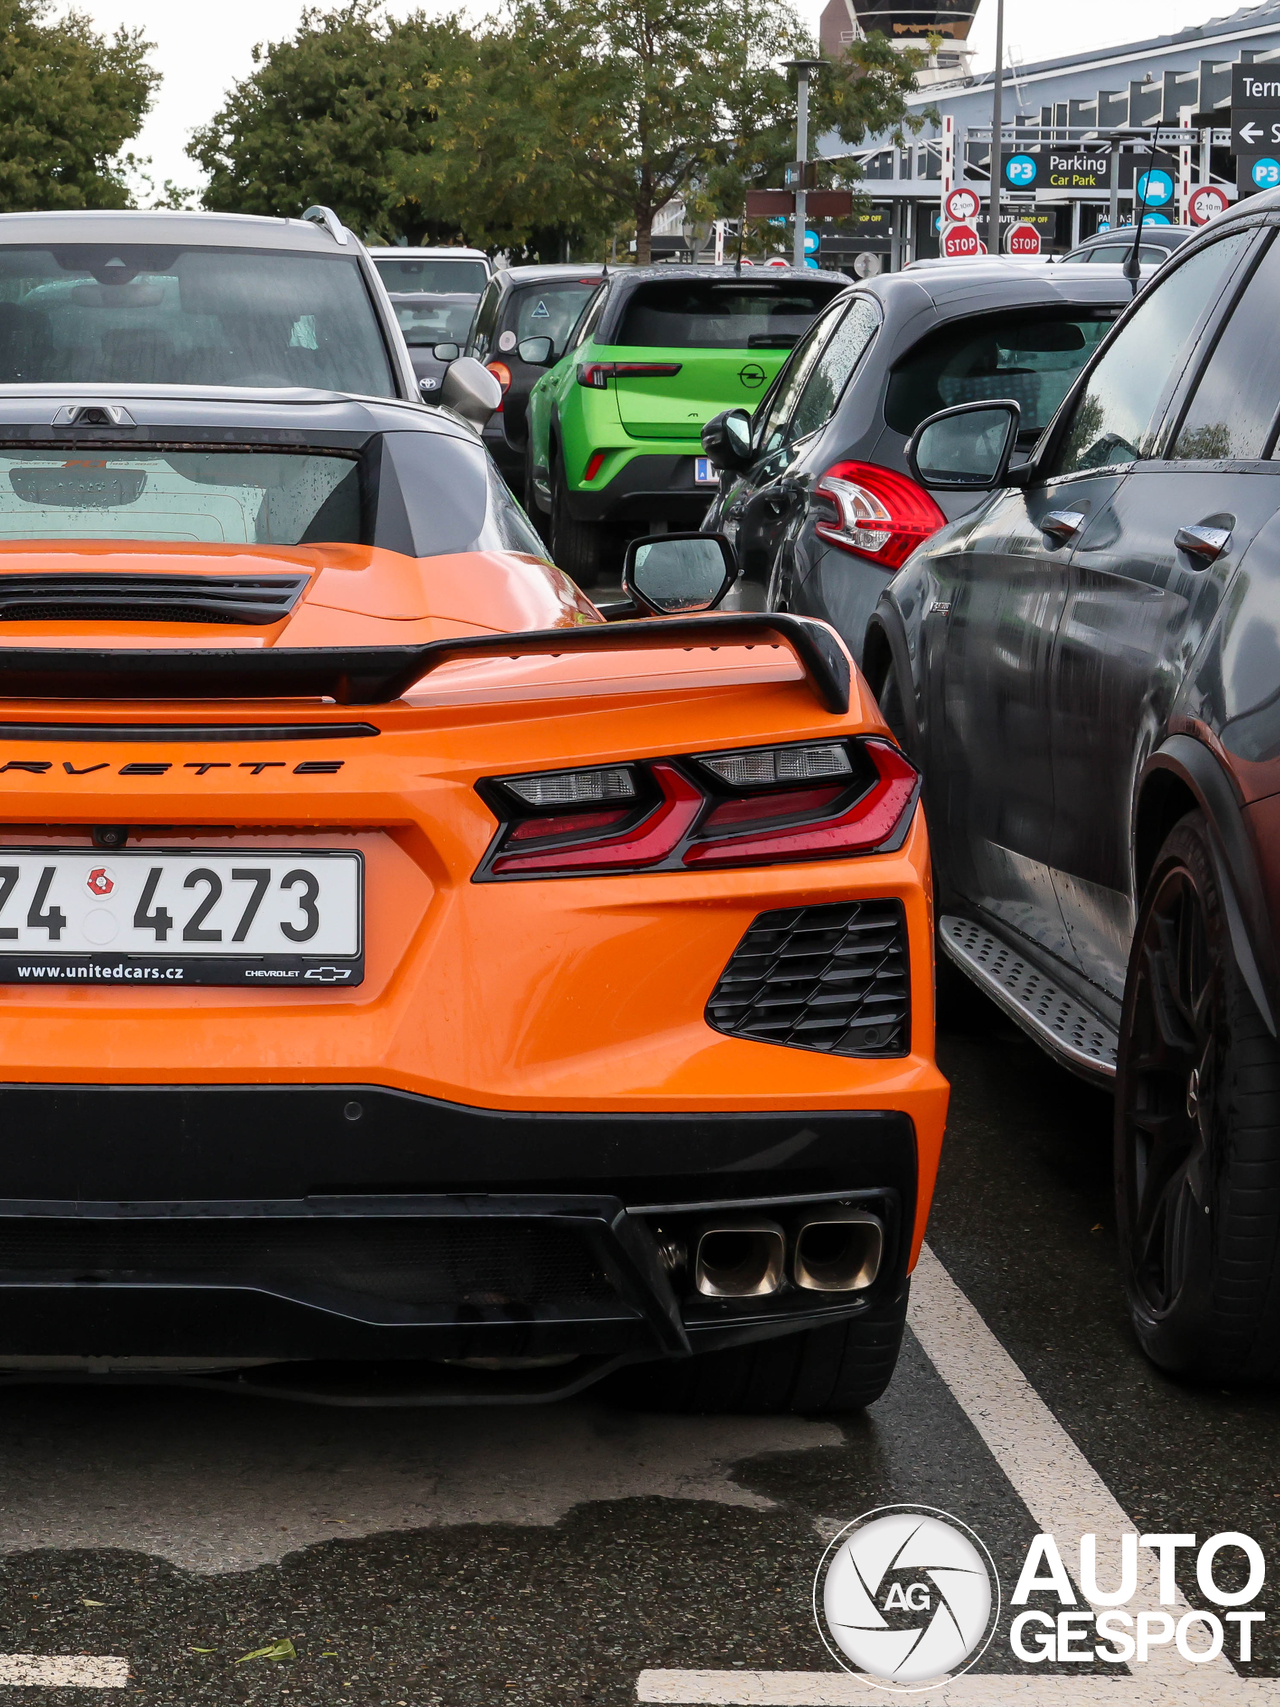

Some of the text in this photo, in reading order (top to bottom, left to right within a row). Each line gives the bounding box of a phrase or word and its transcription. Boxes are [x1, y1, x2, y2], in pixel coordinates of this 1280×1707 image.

[1009, 163, 1033, 179] P3
[1050, 155, 1106, 174] Parking
[1050, 175, 1096, 186] Car Park
[1255, 166, 1279, 182] P3
[947, 238, 976, 253] STOP
[1012, 238, 1038, 250] STOP
[133, 868, 320, 943] 4273
[17, 964, 184, 979] www.unitedcars.cz
[245, 970, 300, 978] CHEVROLET
